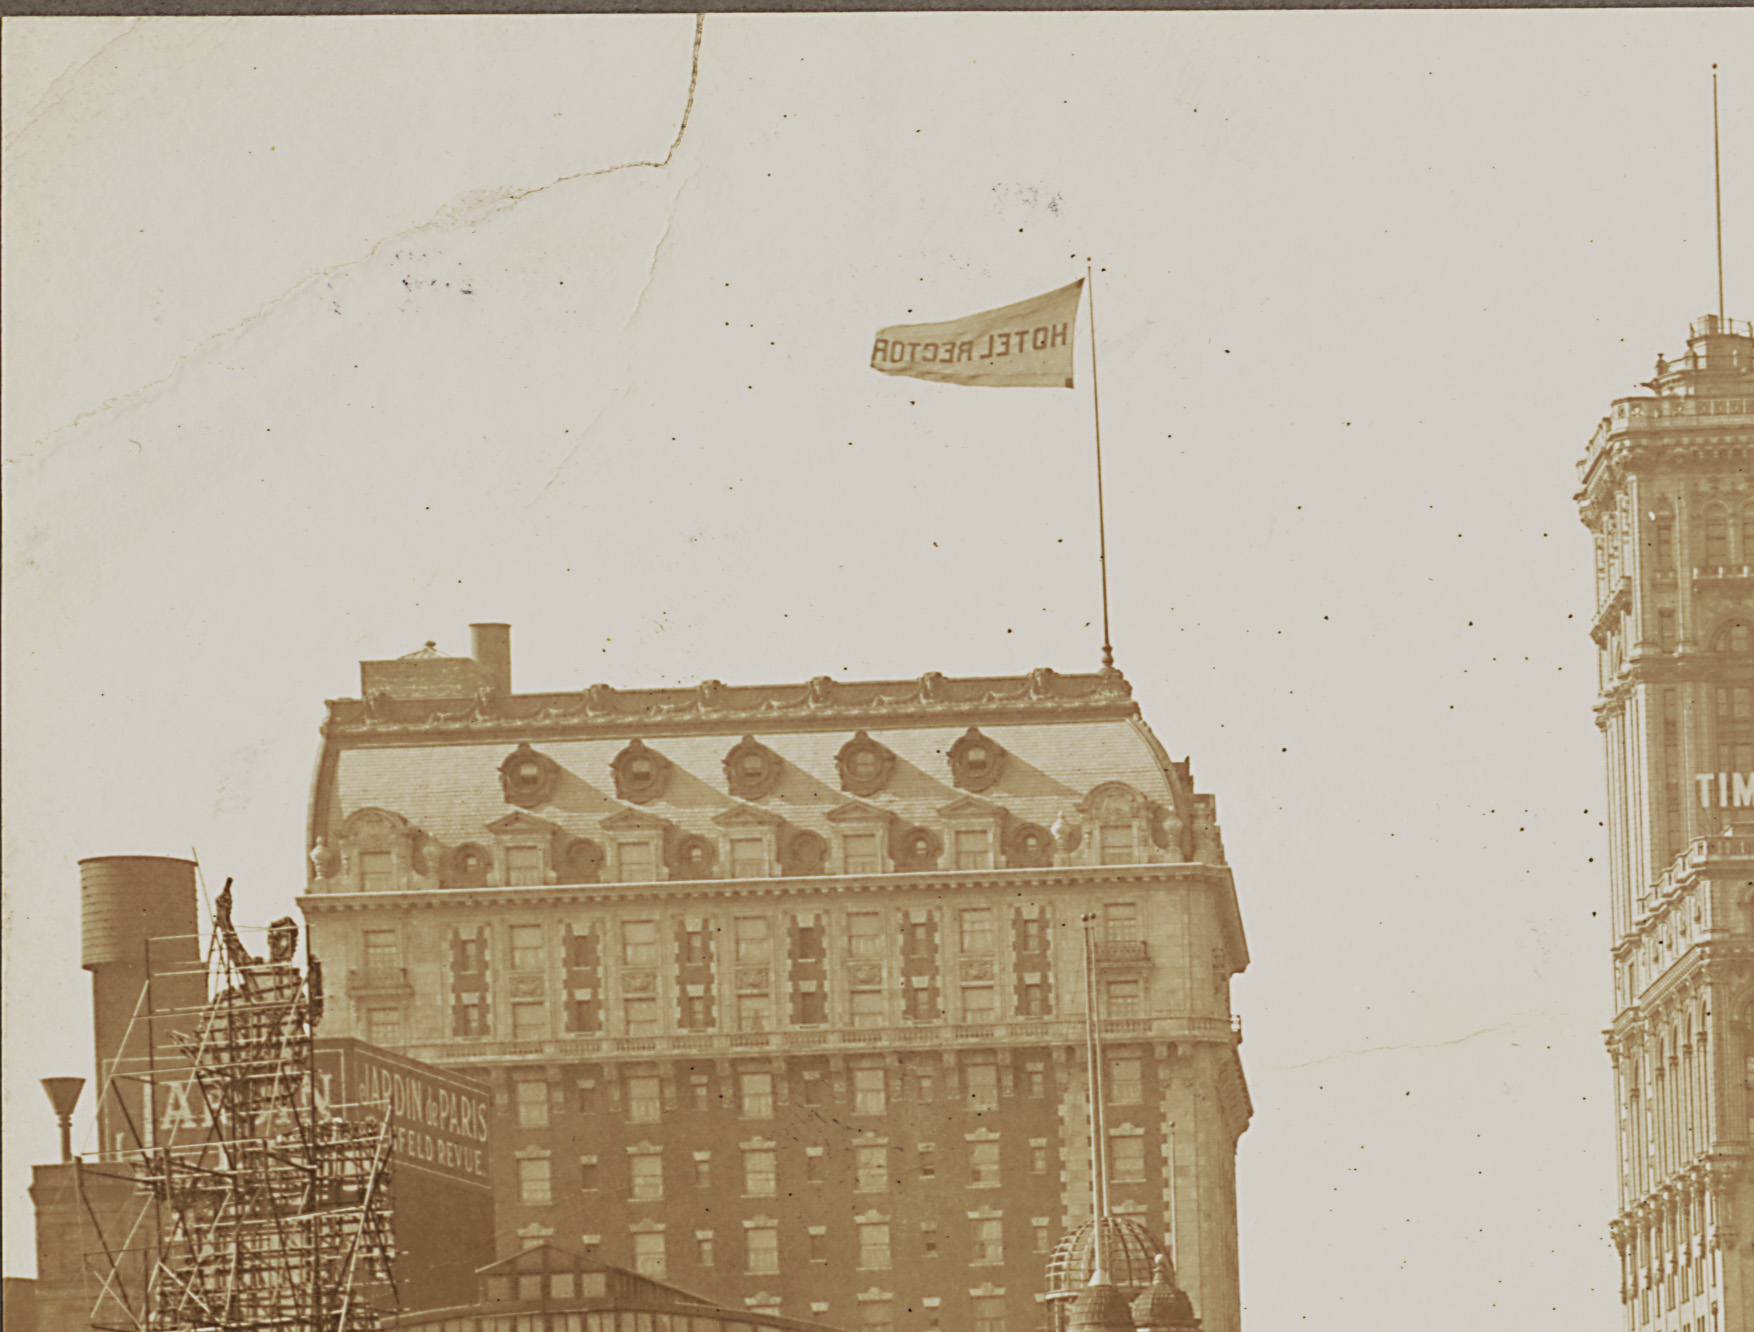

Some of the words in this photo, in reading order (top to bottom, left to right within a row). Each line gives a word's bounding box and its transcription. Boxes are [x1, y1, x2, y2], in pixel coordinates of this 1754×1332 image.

[360, 1065, 422, 1123] JARDIN
[438, 1089, 489, 1143] PARIS
[392, 1127, 434, 1165] FELD
